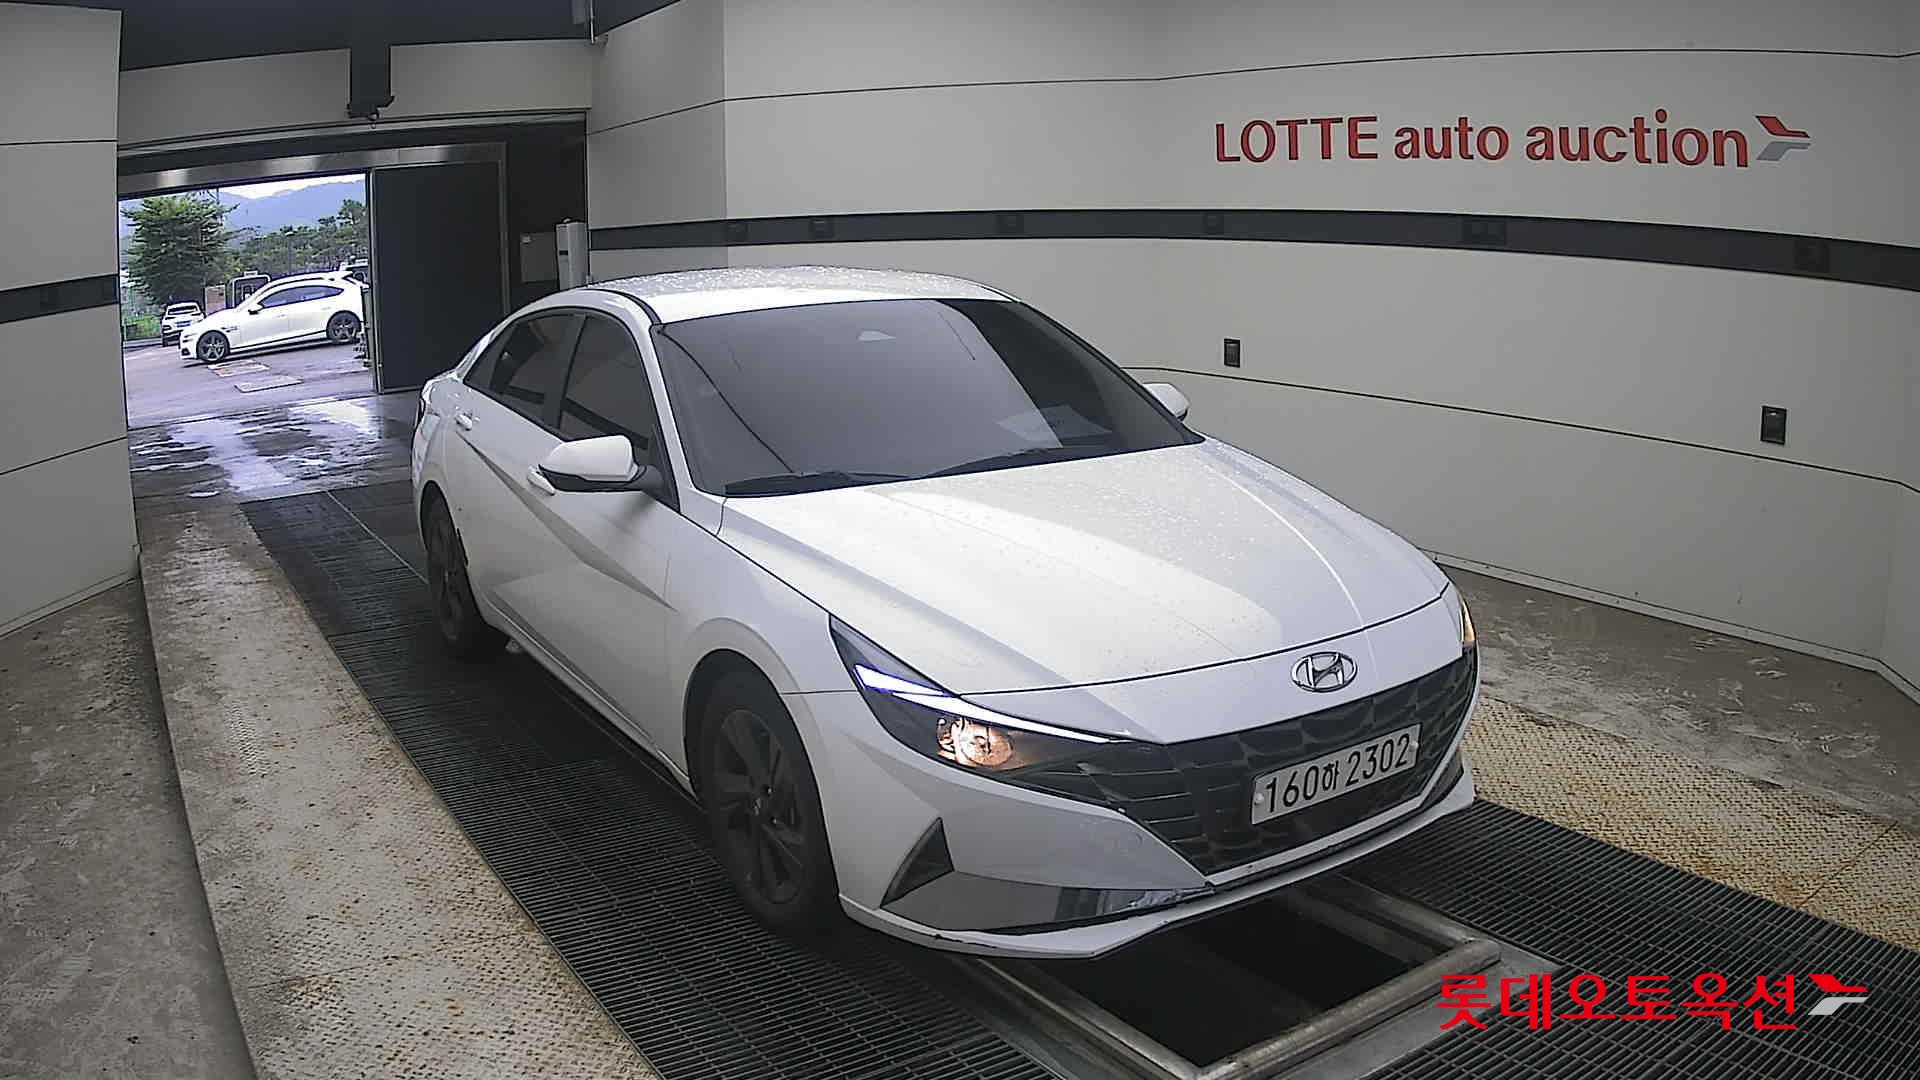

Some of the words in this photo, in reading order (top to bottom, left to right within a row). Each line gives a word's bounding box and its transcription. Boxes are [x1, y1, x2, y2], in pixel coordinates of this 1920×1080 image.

[1215, 116, 1378, 162] LOTTE
[1394, 116, 1510, 161] auto
[1526, 109, 1750, 168] auction
[1266, 760, 1340, 813] 160하
[1345, 733, 1410, 787] 2302
